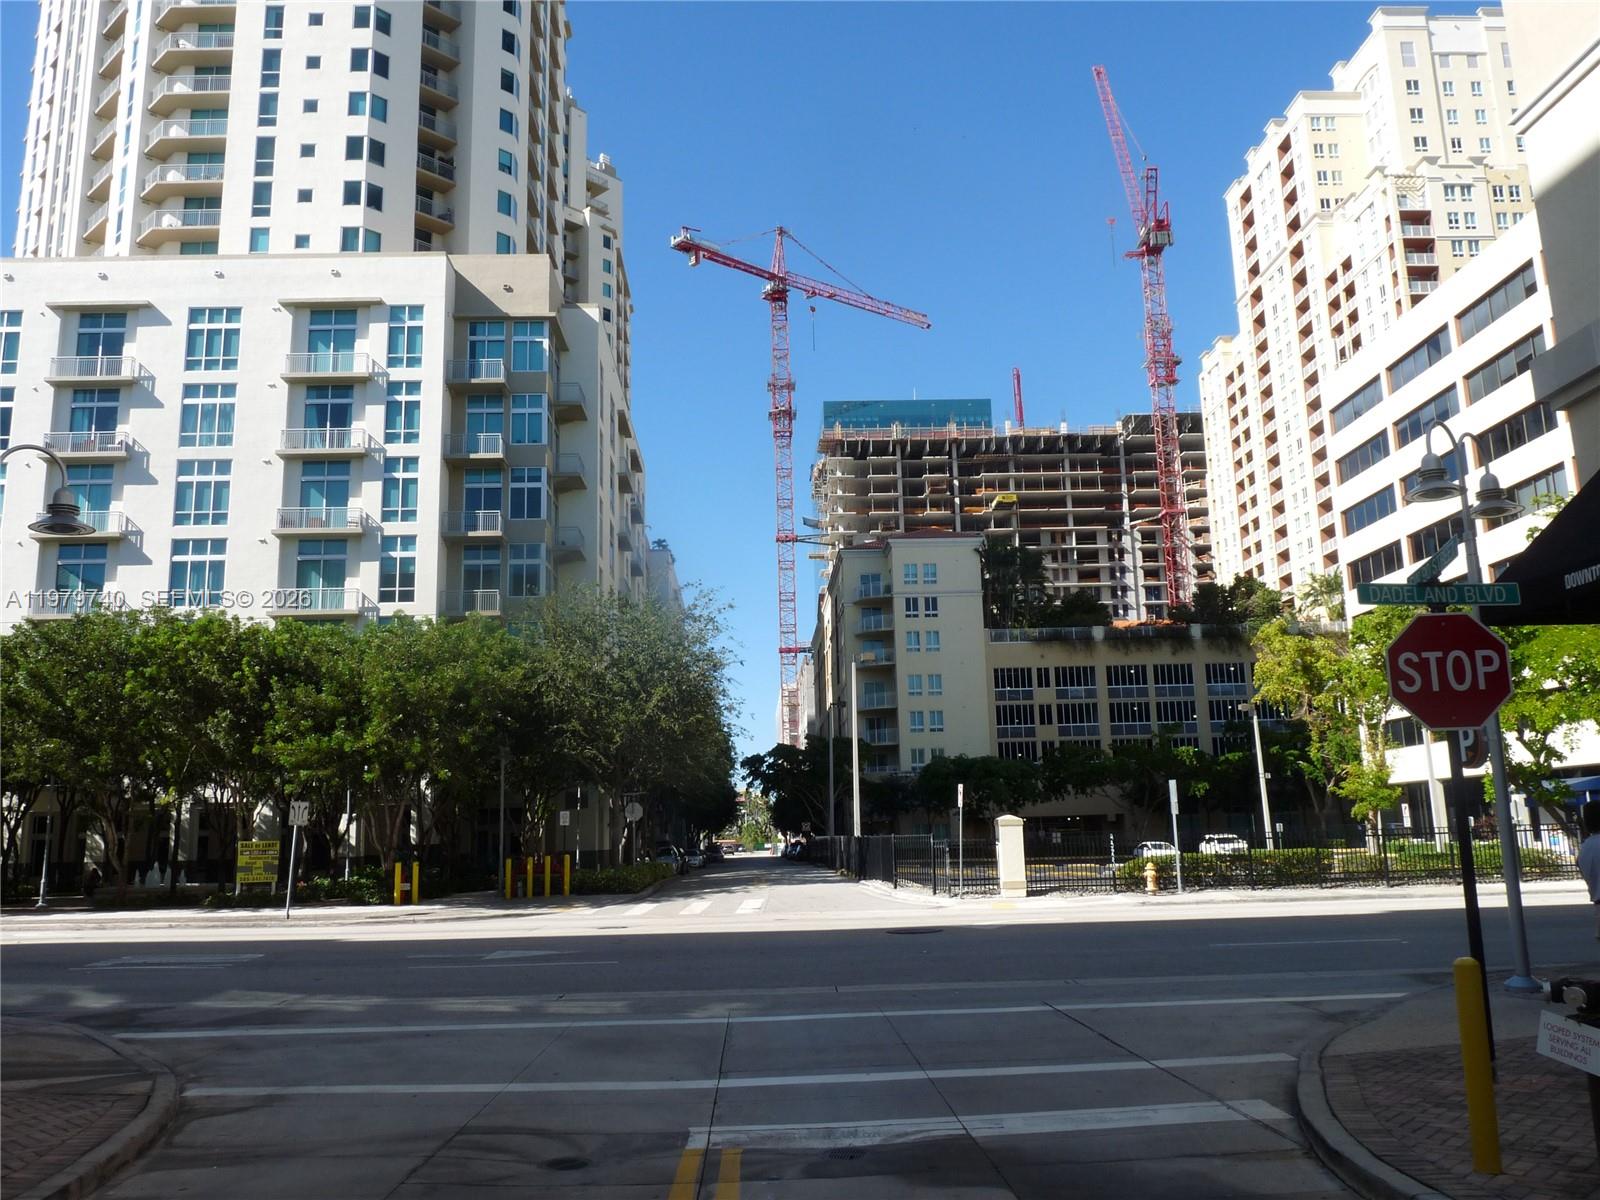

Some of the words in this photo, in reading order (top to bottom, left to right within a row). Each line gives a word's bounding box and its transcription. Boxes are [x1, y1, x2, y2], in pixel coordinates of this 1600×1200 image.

[1368, 585, 1458, 603] DADELAND
[1463, 585, 1507, 603] BLVD
[1397, 649, 1500, 693] STOP
[1458, 727, 1474, 762] P
